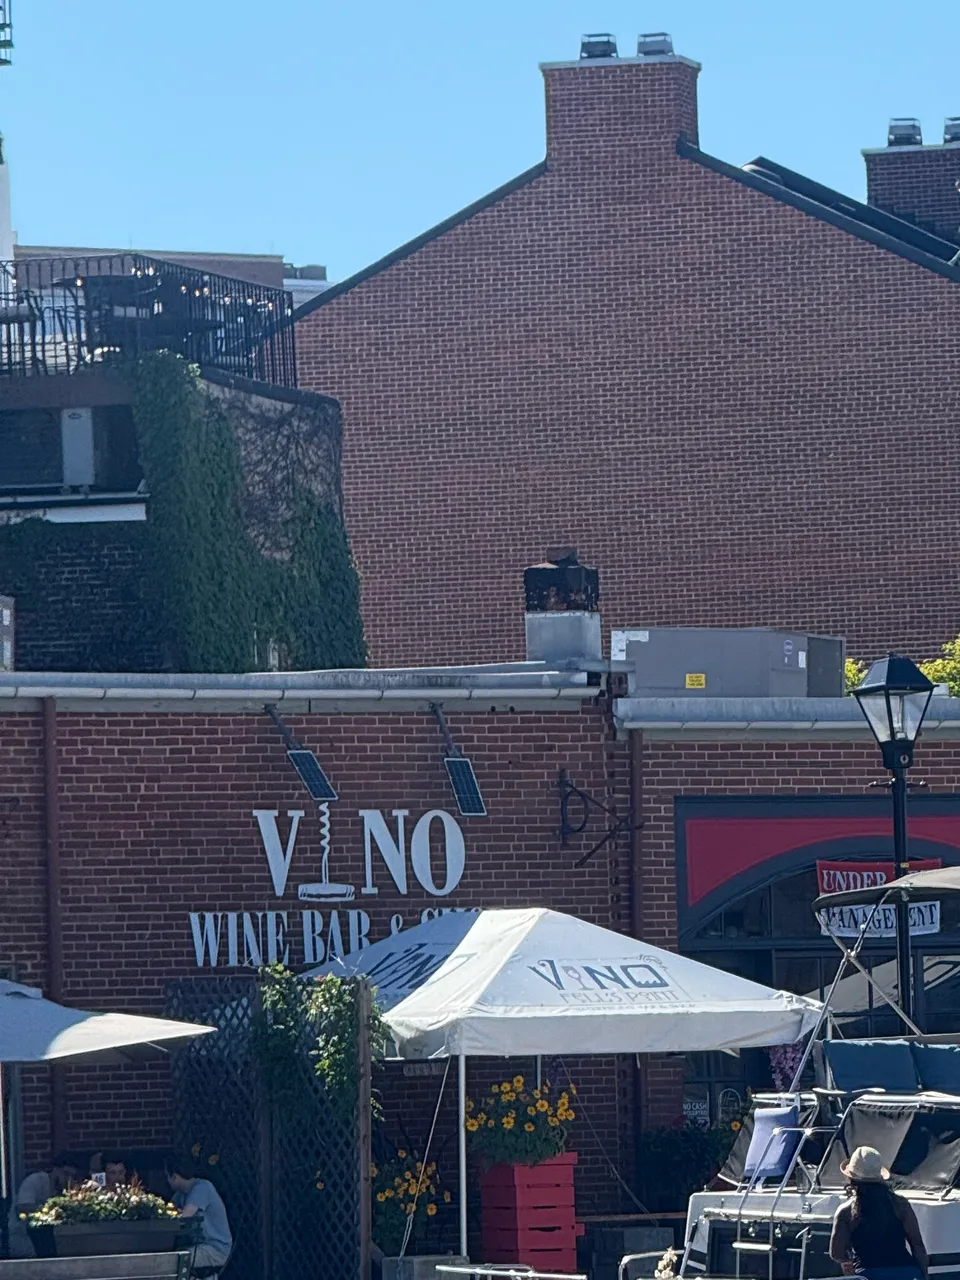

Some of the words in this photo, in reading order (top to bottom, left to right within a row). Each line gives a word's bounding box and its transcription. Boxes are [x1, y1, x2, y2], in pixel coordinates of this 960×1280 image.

[252, 802, 466, 901] VINO
[822, 870, 887, 892] UNDER
[189, 911, 289, 967] WINE
[302, 909, 371, 965] BAR
